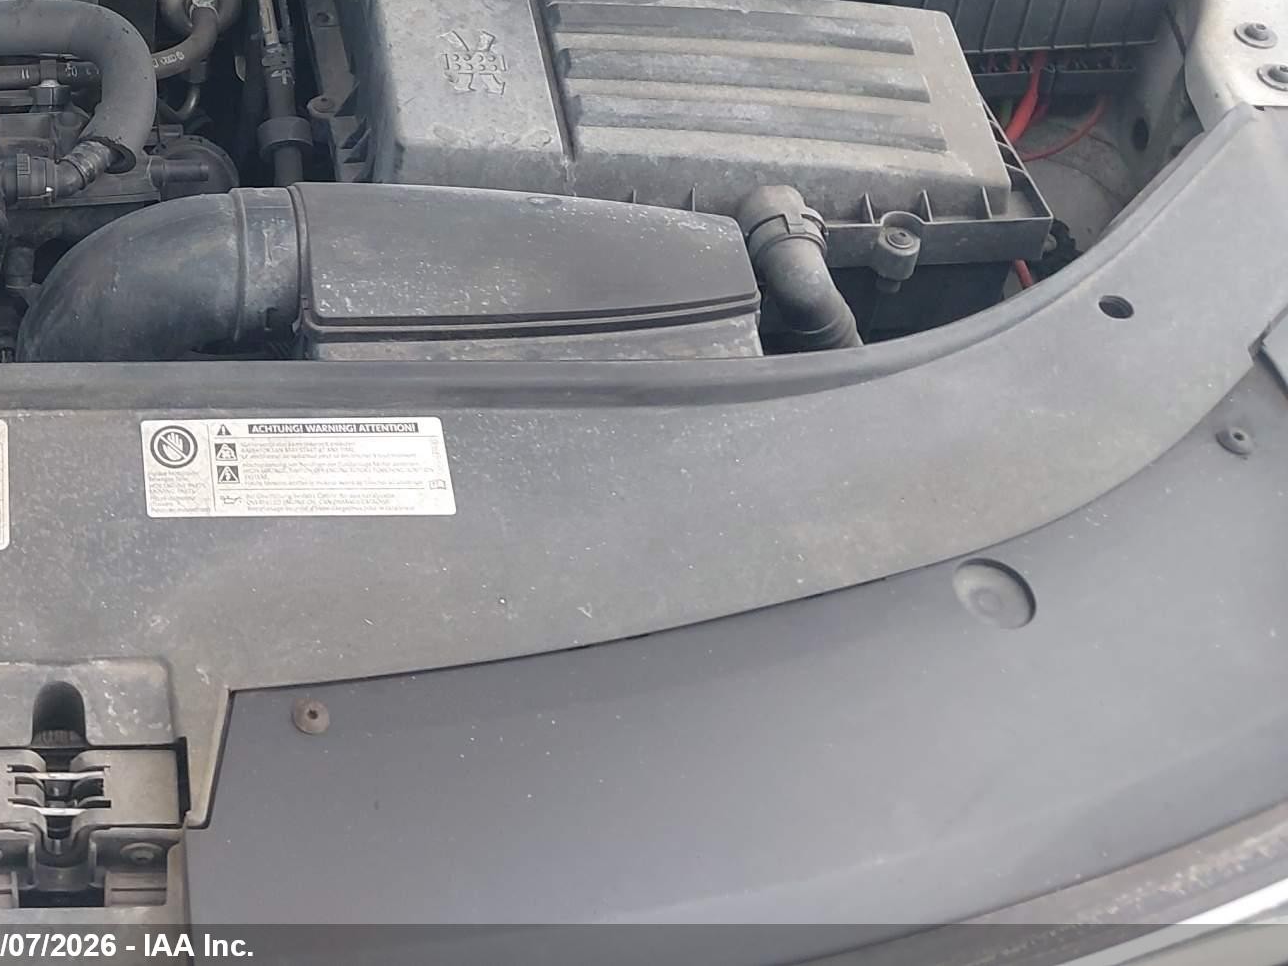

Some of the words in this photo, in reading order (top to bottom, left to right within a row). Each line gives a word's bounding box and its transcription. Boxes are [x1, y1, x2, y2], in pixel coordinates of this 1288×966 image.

[251, 424, 304, 433] ACHTUNG!
[306, 423, 357, 433] WARNING!
[358, 422, 417, 432] ATTENTION!
